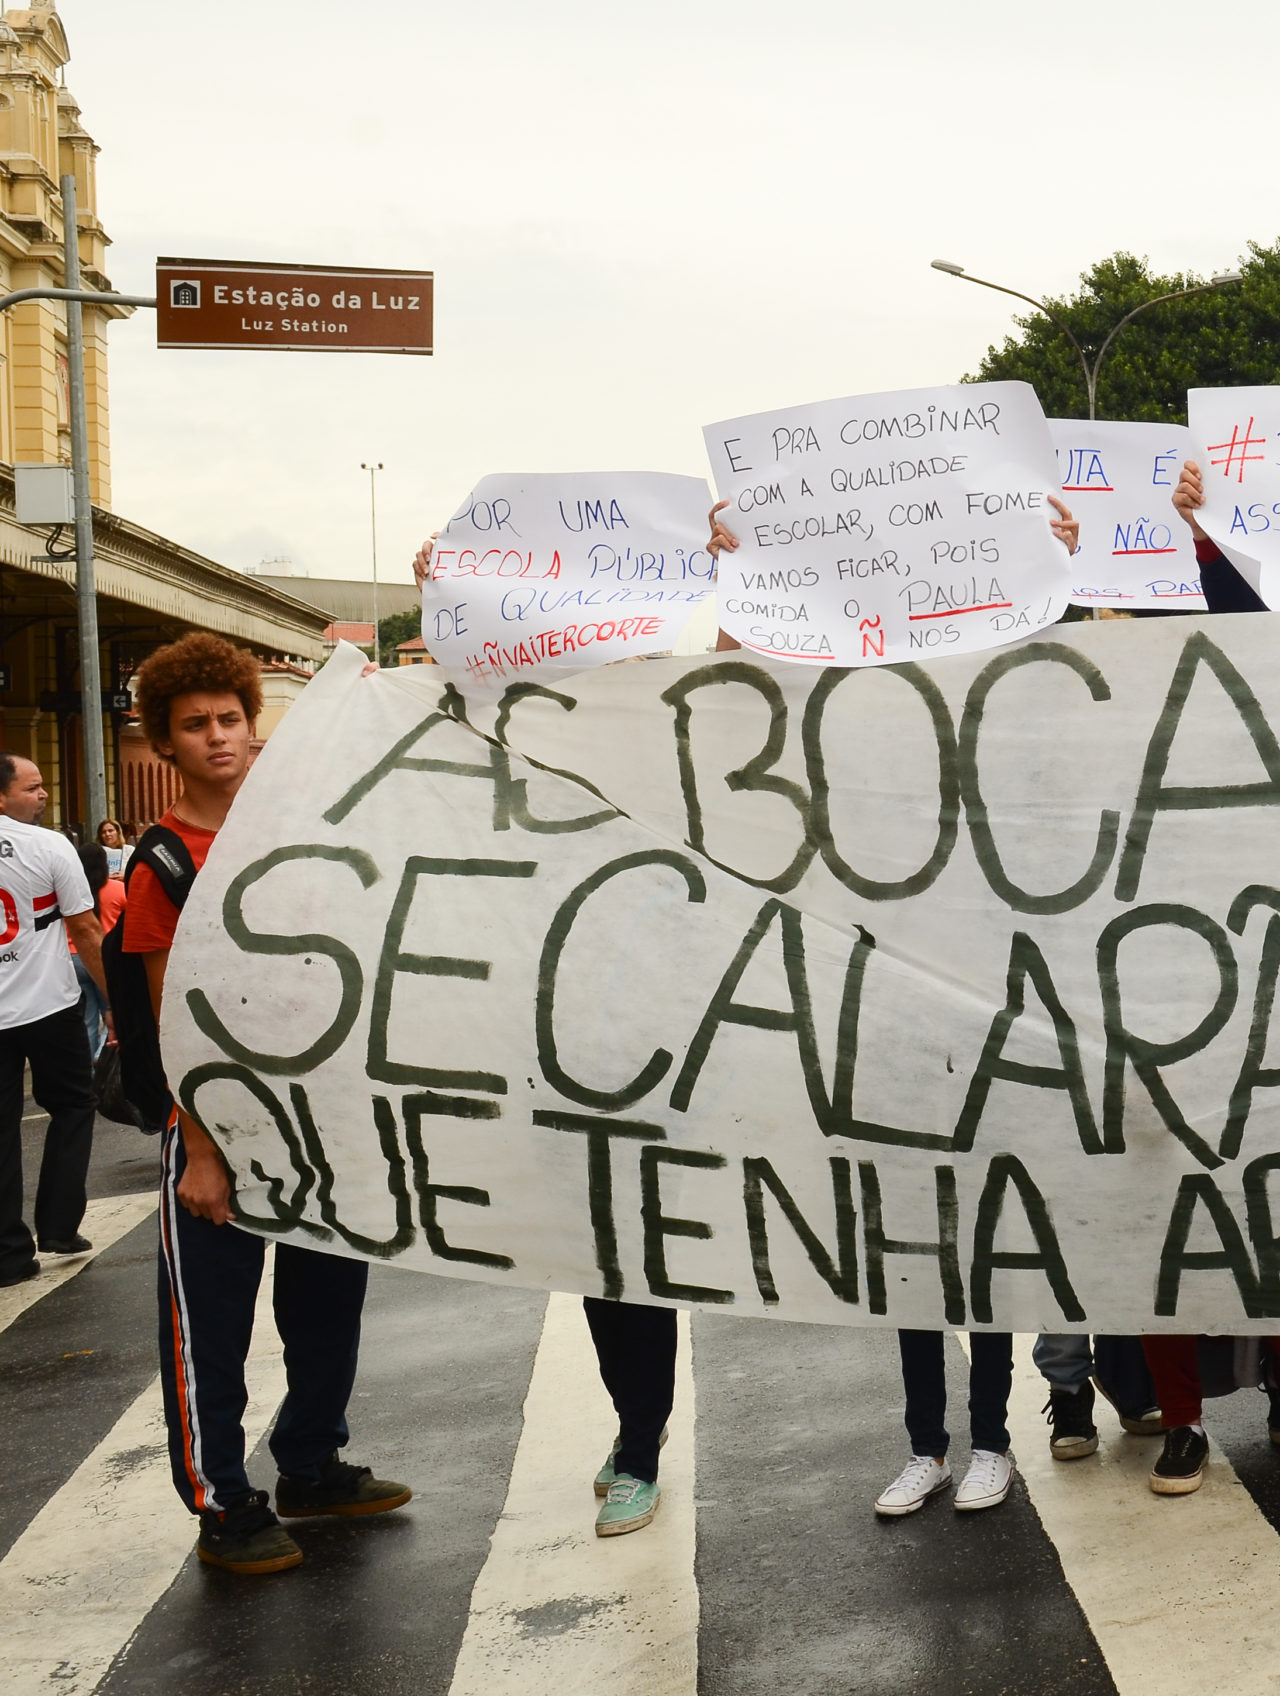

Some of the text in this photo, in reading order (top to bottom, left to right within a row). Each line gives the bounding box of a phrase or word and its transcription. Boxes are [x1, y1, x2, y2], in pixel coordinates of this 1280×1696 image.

[214, 285, 420, 311] Estação da Luz
[242, 317, 348, 333] Luz Station
[724, 438, 753, 473] E
[772, 426, 821, 461] PRA
[1152, 448, 1178, 486] É
[737, 484, 786, 513] COM
[800, 478, 814, 497] A
[888, 500, 944, 527] COM
[965, 492, 1044, 516] FOME
[558, 498, 630, 533] UMA
[1113, 516, 1172, 552] NÃO
[432, 549, 561, 581] ESCOLA
[740, 566, 820, 593] VAMOS
[843, 599, 861, 619] O
[899, 577, 1006, 612] PAULA
[433, 602, 469, 641] DE
[749, 626, 833, 654] SOUZA
[859, 614, 885, 658] Ñ
[908, 624, 961, 649] NOS
[322, 682, 630, 833] AS
[186, 842, 538, 1095] SE
[180, 1061, 517, 1270] QUE
[532, 1109, 1087, 1325] TENHA
